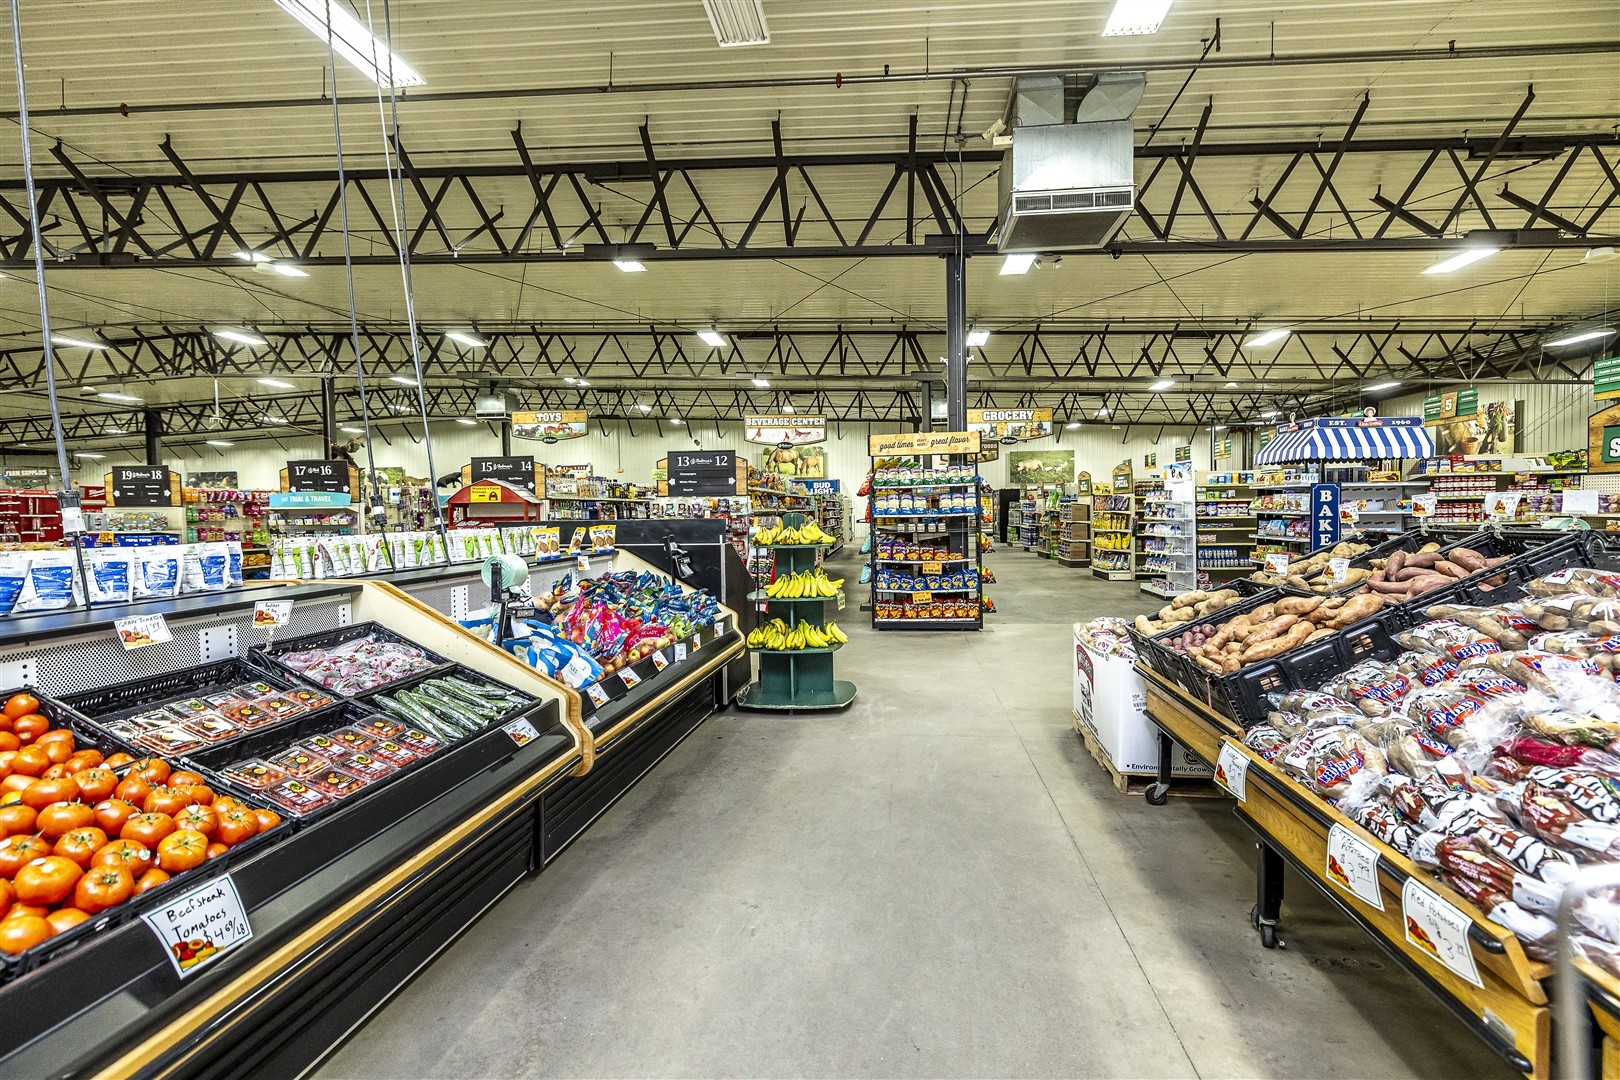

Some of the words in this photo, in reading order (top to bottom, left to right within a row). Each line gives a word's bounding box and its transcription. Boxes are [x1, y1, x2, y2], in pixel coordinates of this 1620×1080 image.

[1445, 398, 1453, 411] 5
[536, 412, 562, 422] TOYS
[983, 410, 1034, 421] GROCERY
[745, 418, 790, 426] BEVERAGE
[791, 418, 826, 426] CENTER
[879, 441, 896, 452] good
[897, 441, 914, 449] times
[930, 437, 948, 447] great
[948, 436, 970, 446] flavor
[520, 461, 532, 471] 14
[677, 456, 690, 467] 13
[715, 455, 728, 466] 12
[294, 465, 306, 476] 17
[320, 465, 332, 476] 16
[481, 462, 493, 472] 15
[121, 470, 132, 480] 19
[150, 470, 162, 480] 18
[310, 495, 332, 503] TRAVEL
[1318, 489, 1334, 547] BAKE
